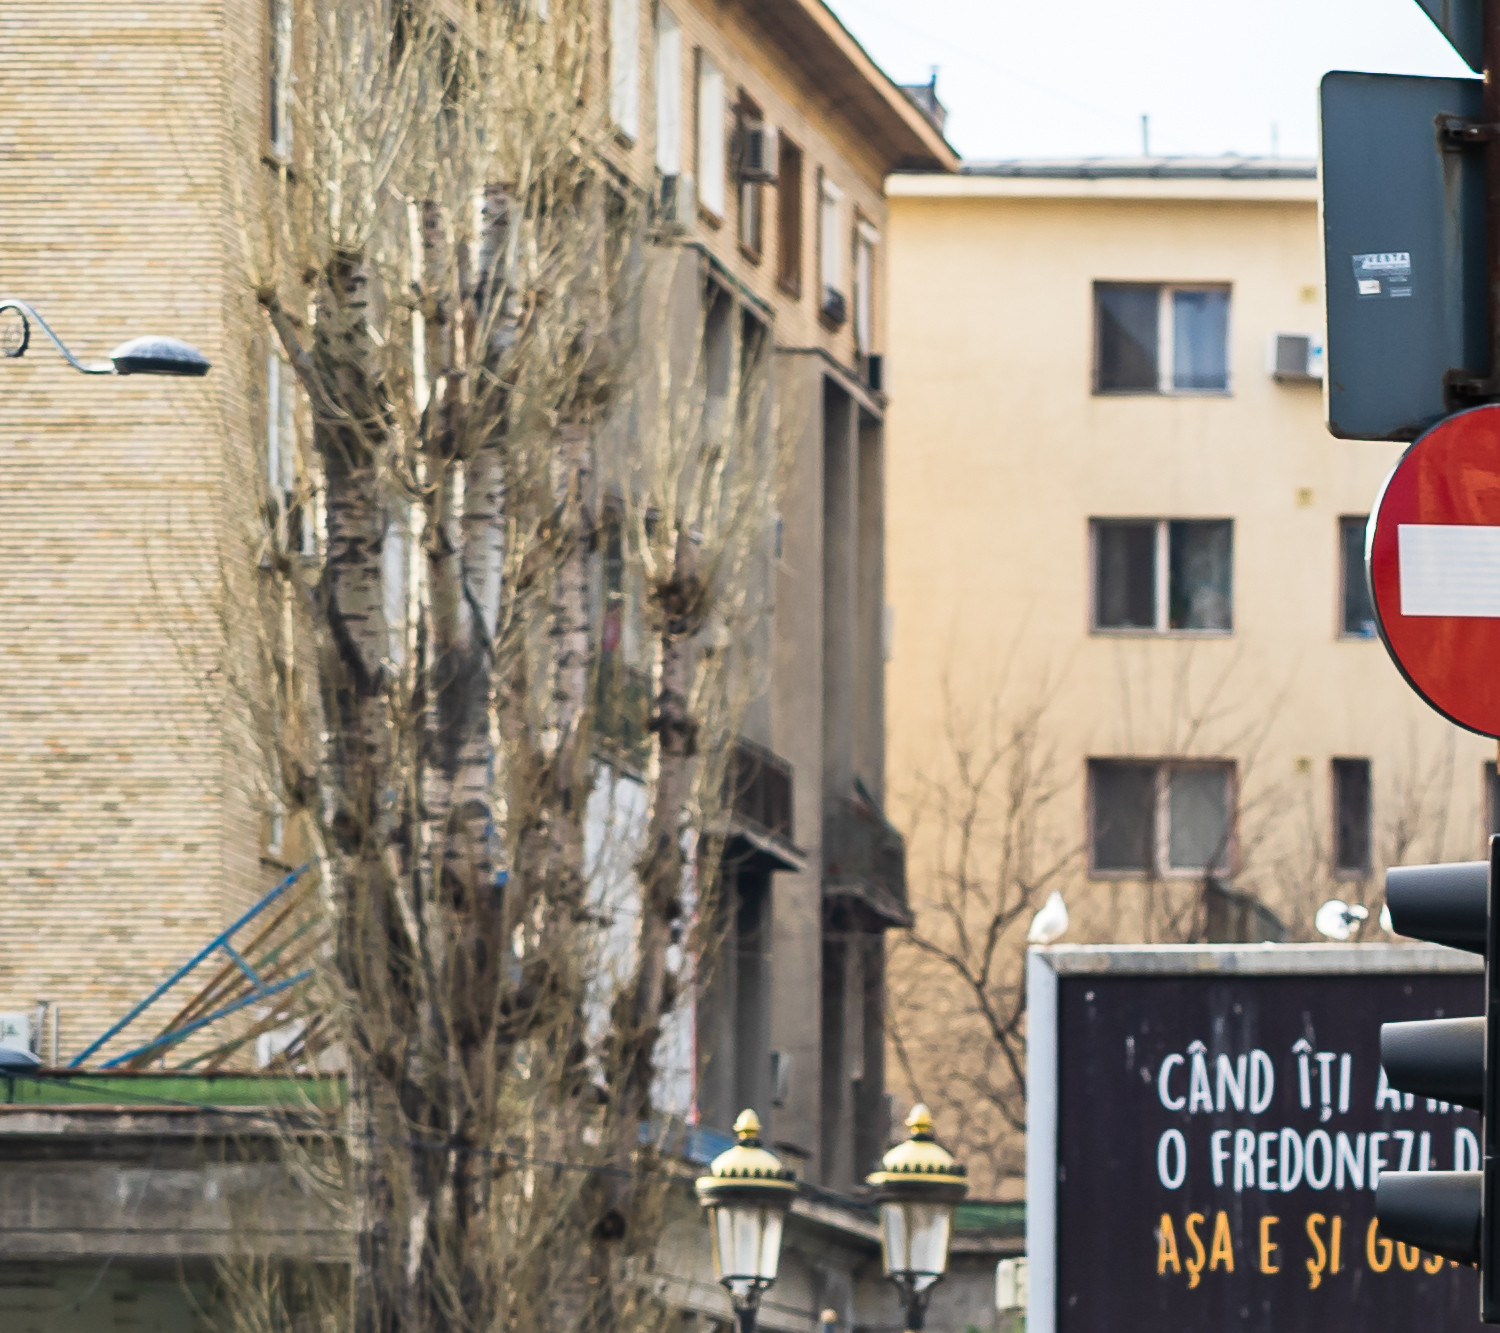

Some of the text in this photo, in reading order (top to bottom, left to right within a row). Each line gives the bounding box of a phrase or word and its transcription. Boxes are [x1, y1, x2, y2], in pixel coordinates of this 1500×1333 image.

[1157, 1039, 1275, 1114] CÂND
[1156, 1127, 1188, 1191] O
[1210, 1127, 1432, 1193] FREDONEZI
[1259, 1215, 1281, 1274] E
